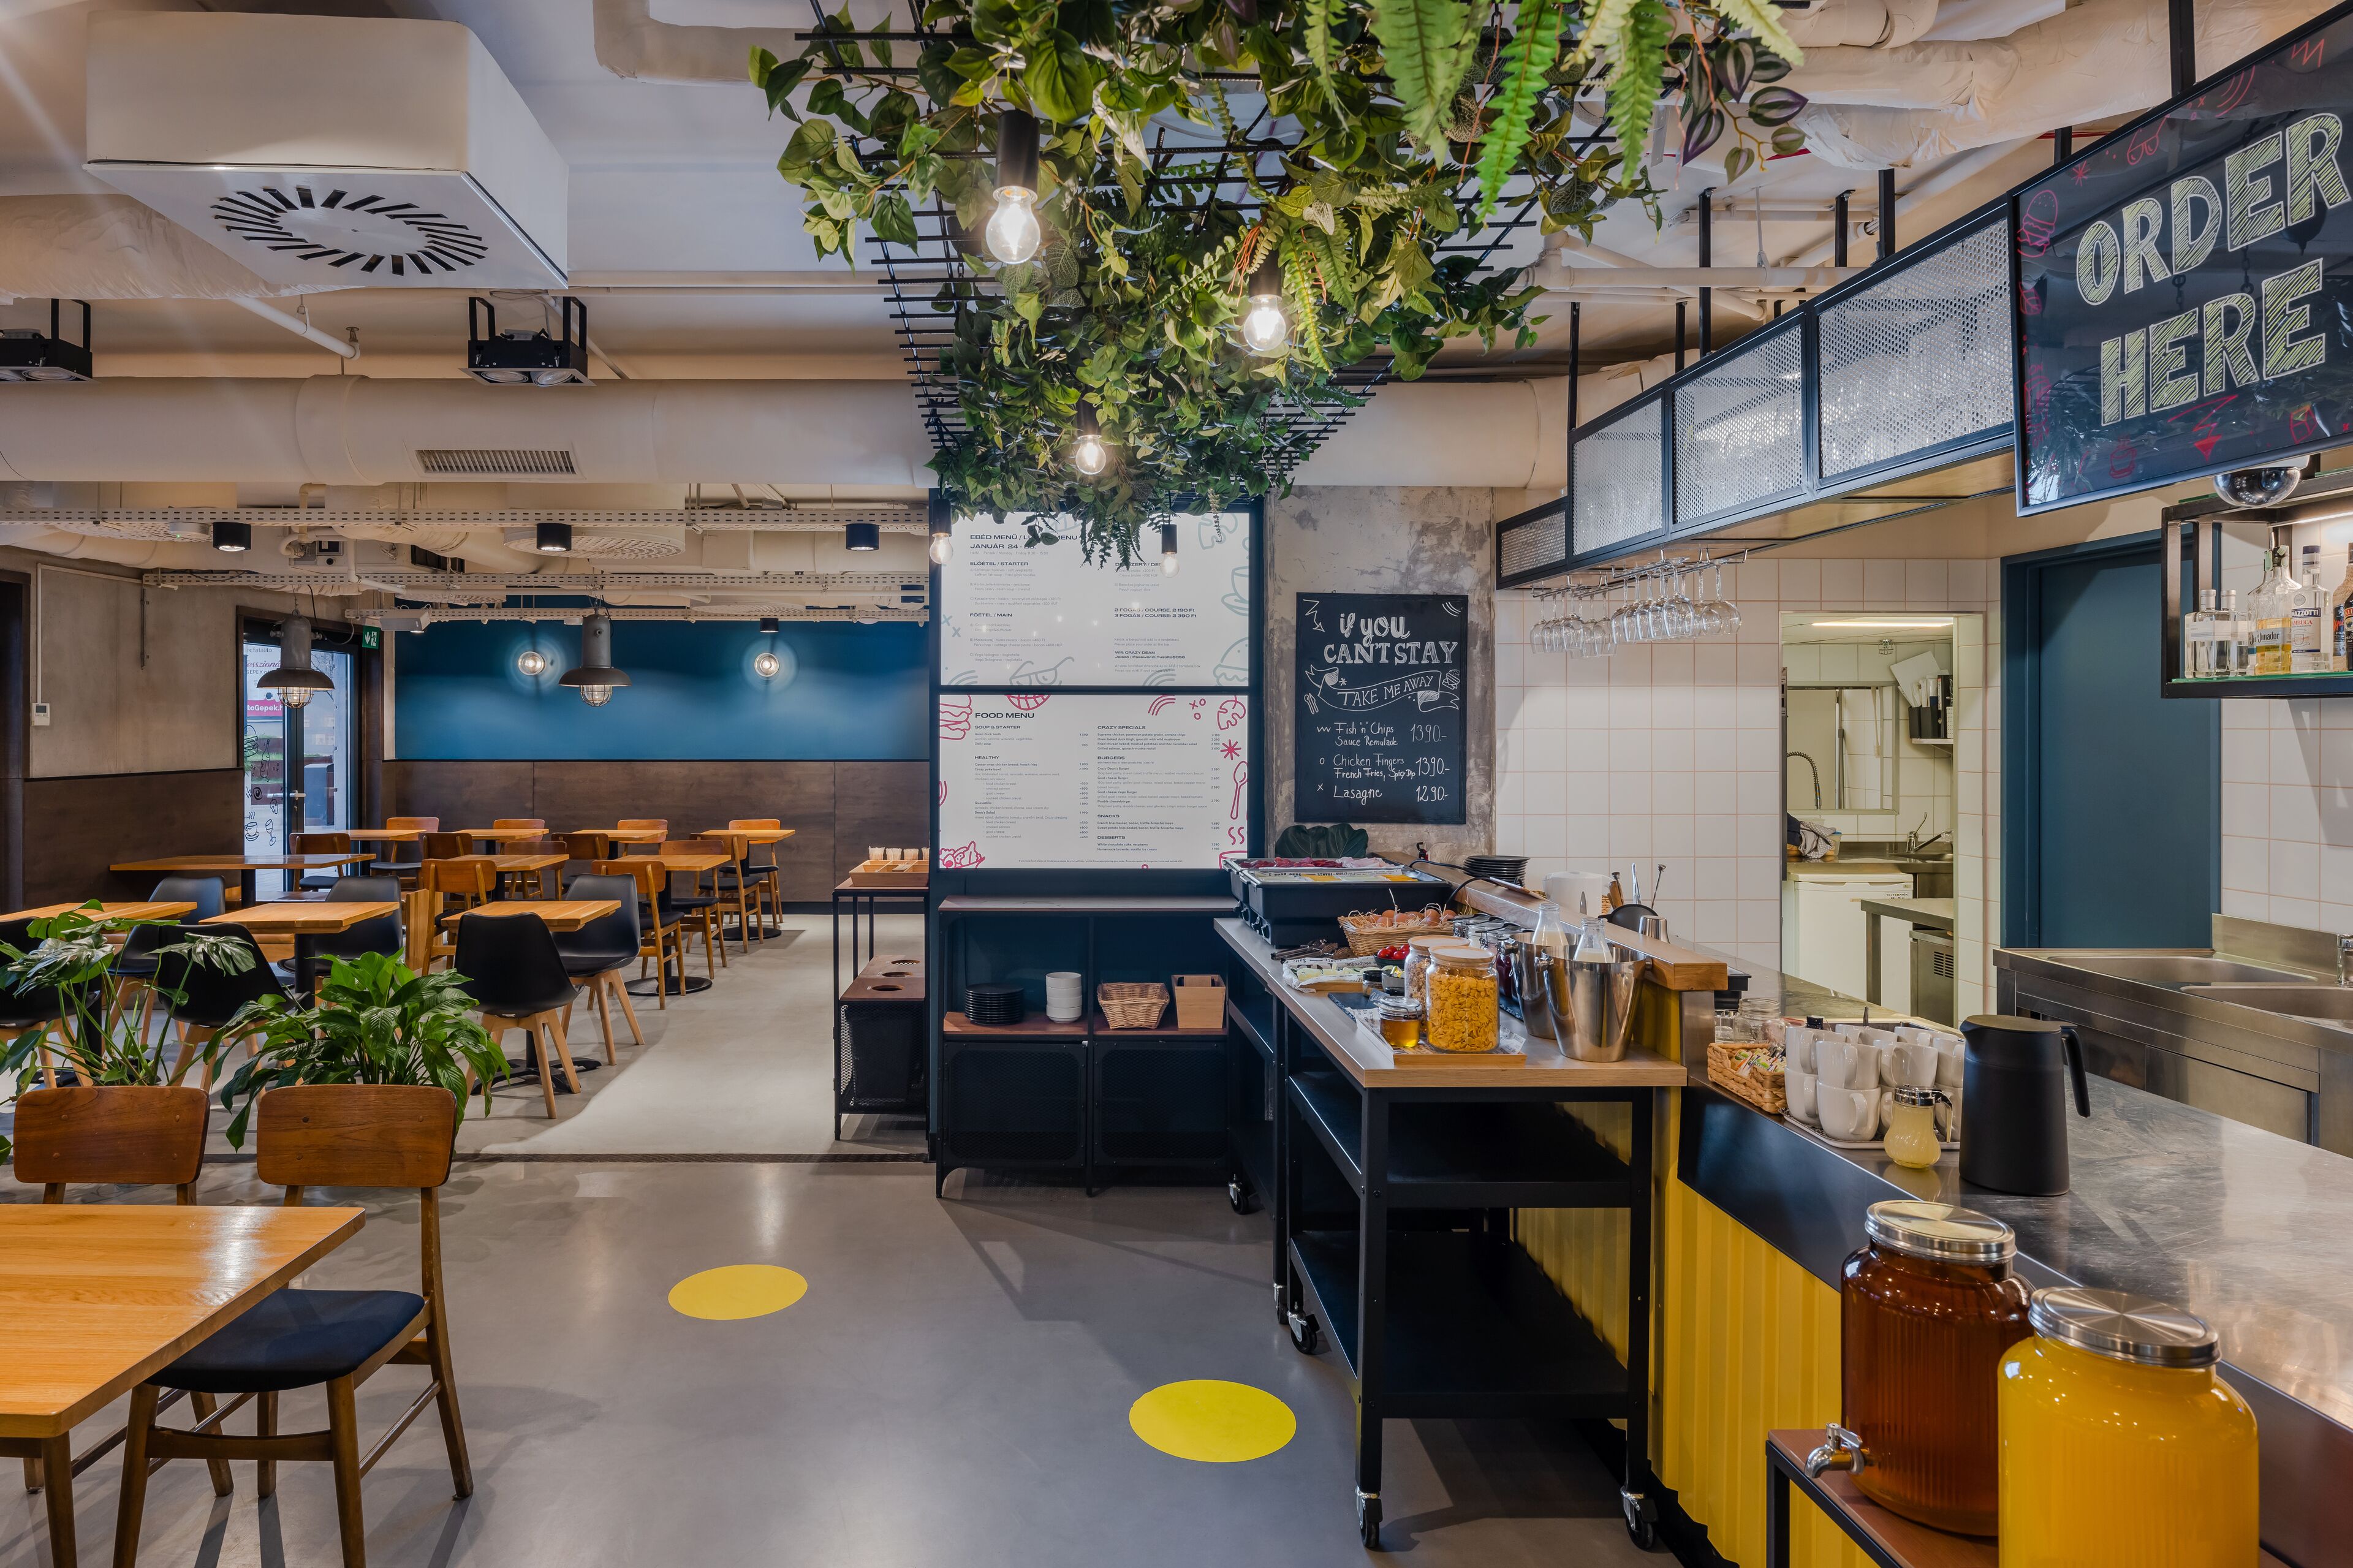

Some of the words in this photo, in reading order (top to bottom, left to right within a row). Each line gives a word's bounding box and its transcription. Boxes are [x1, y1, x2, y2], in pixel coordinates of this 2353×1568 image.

[2076, 113, 2352, 306] ORDER
[2101, 257, 2326, 426] HERE
[1339, 613, 1355, 638] if
[1360, 616, 1411, 648] you
[2258, 631, 2280, 643] Jimador
[1324, 642, 1390, 664] CAN'T
[1395, 641, 1458, 666] STAY
[1337, 689, 1379, 706] TAKE
[1384, 684, 1401, 700] ME
[1403, 676, 1433, 692] AWAY
[1333, 721, 1357, 735] Fish
[1370, 722, 1394, 737] Chips
[1335, 735, 1361, 746] Sauce
[1363, 735, 1398, 746] Remulade
[1333, 753, 1371, 767] Chicken
[1373, 753, 1404, 771] Fingers
[1333, 767, 1362, 779] French
[1363, 768, 1385, 781] Fries,
[1388, 768, 1406, 781] Spicy
[1406, 769, 1416, 780] Dip
[1333, 785, 1382, 806] Lasagne
